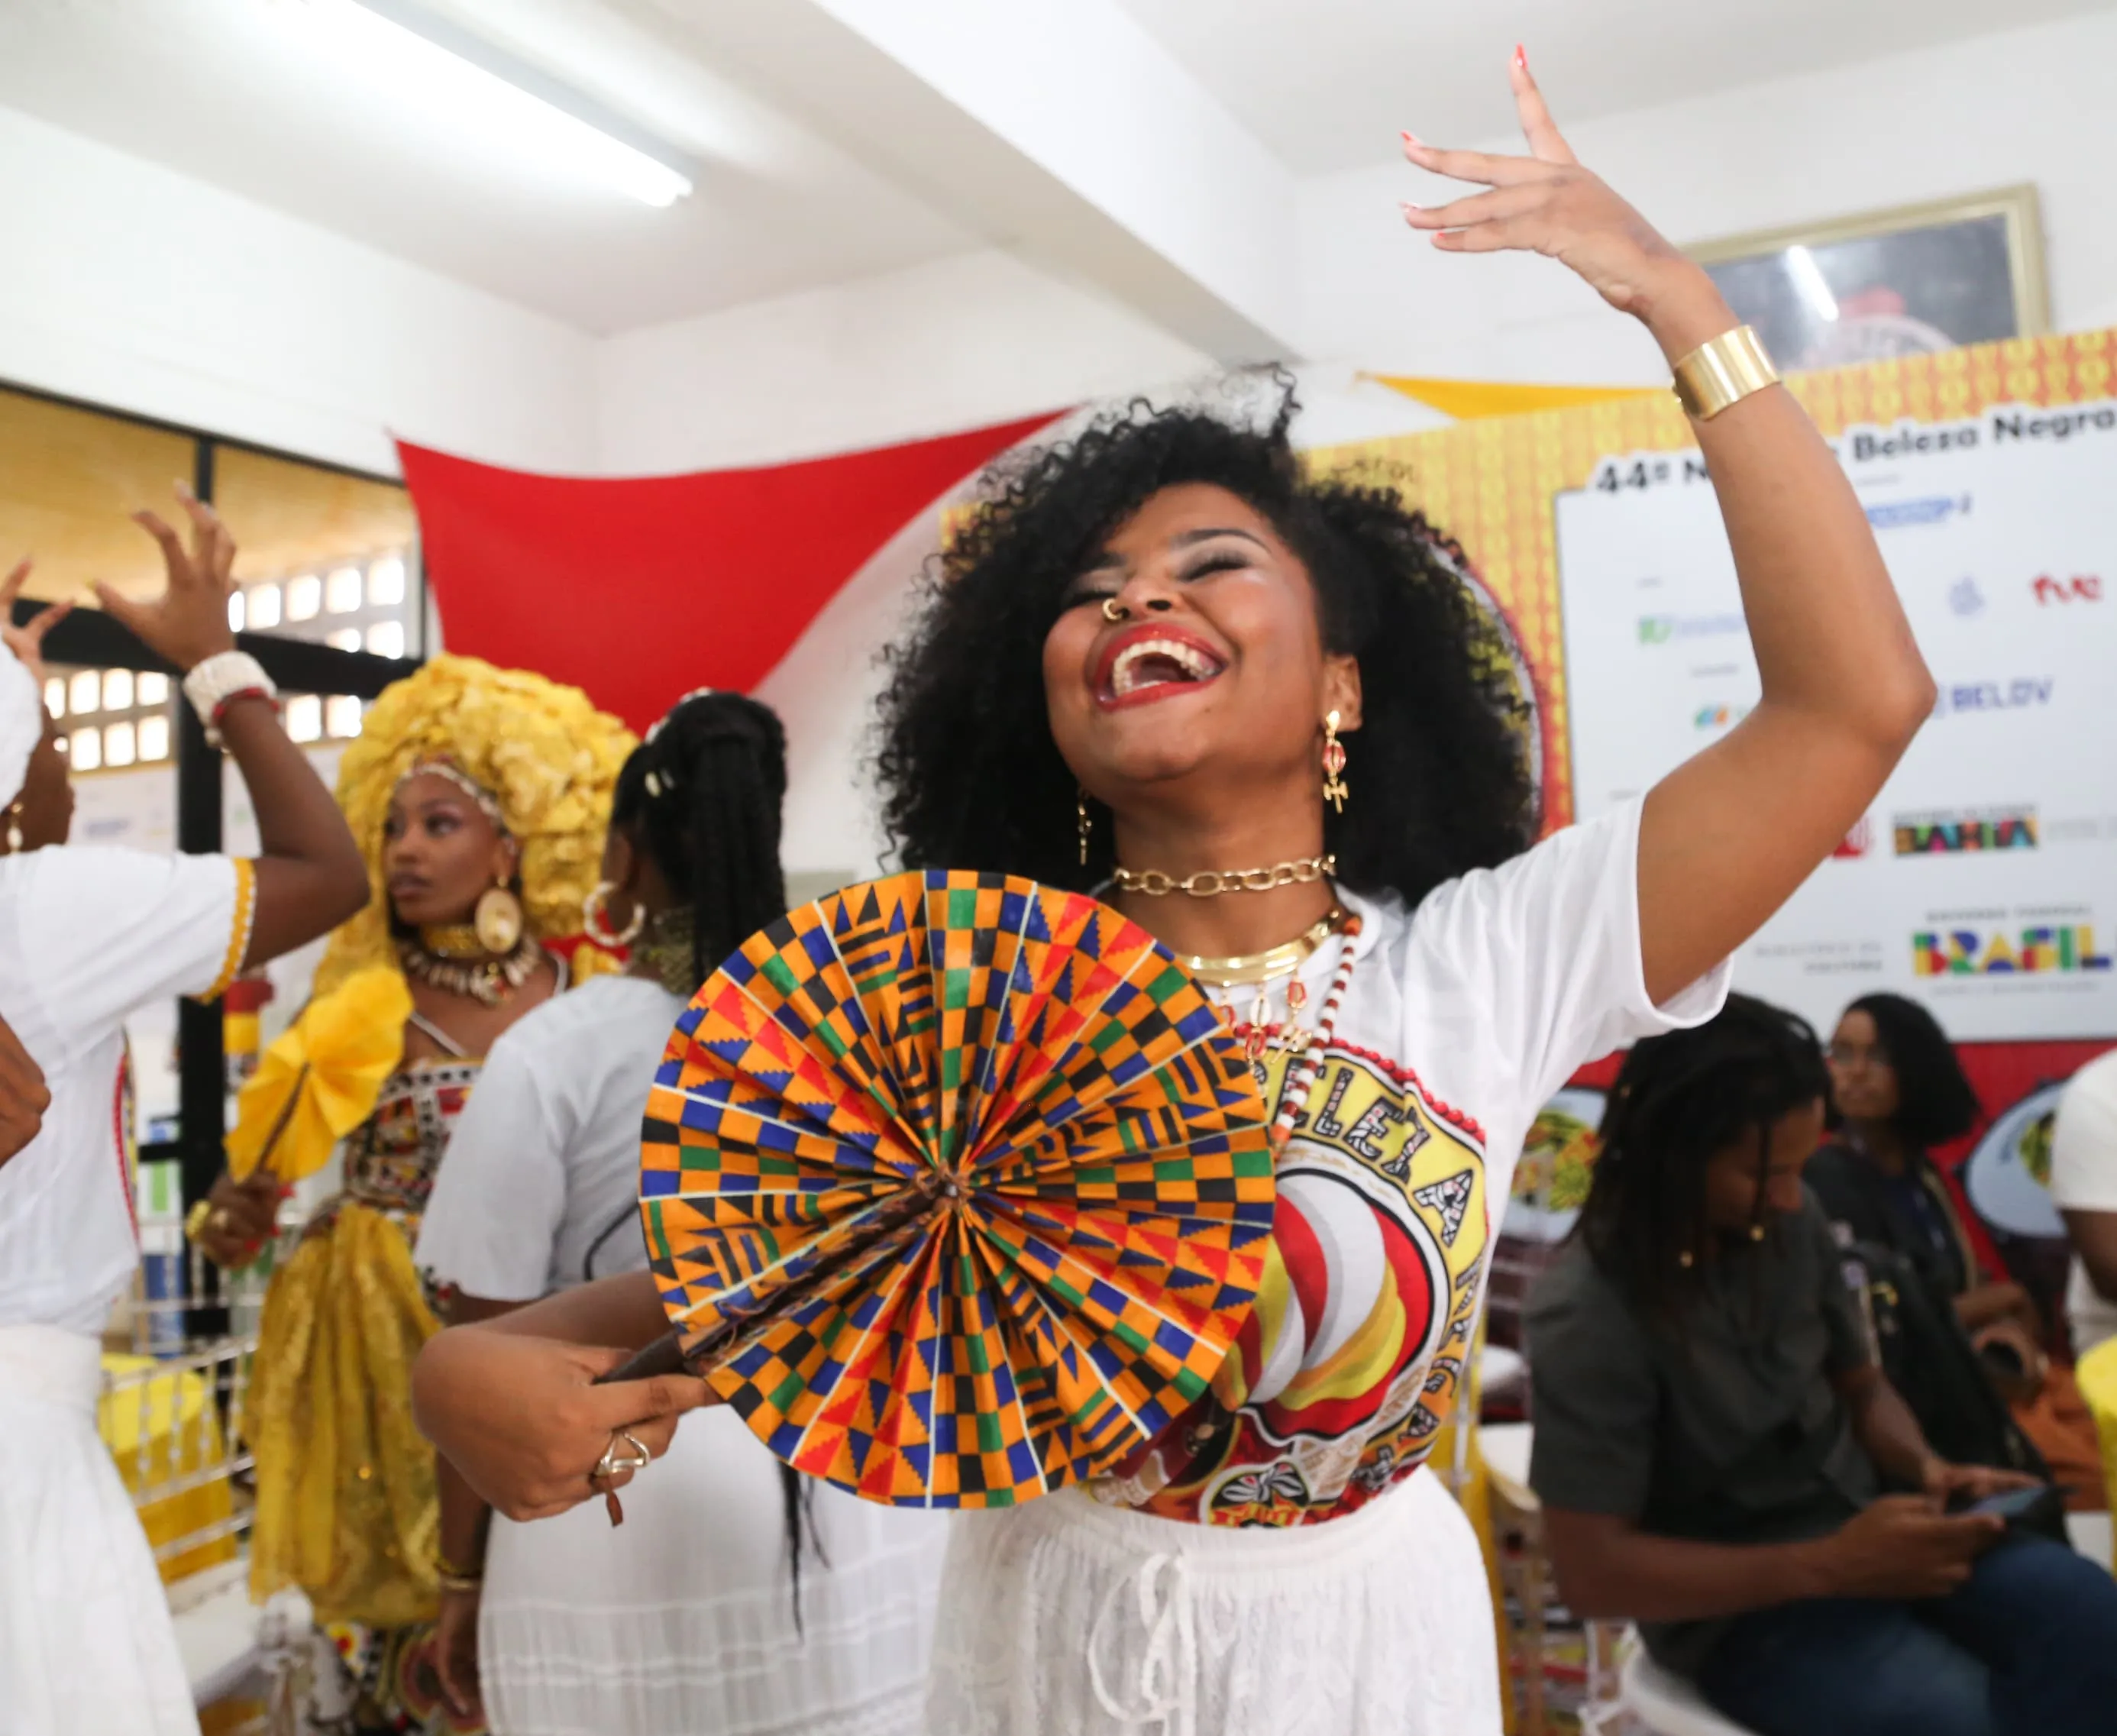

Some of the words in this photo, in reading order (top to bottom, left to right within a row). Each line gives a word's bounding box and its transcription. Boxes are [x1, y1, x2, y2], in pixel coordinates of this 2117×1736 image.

[1854, 426, 1980, 463] Beleza
[1993, 409, 2117, 441] Negra
[1912, 924, 2112, 977] BRASIL
[1253, 1056, 1474, 1248] ELEZA
